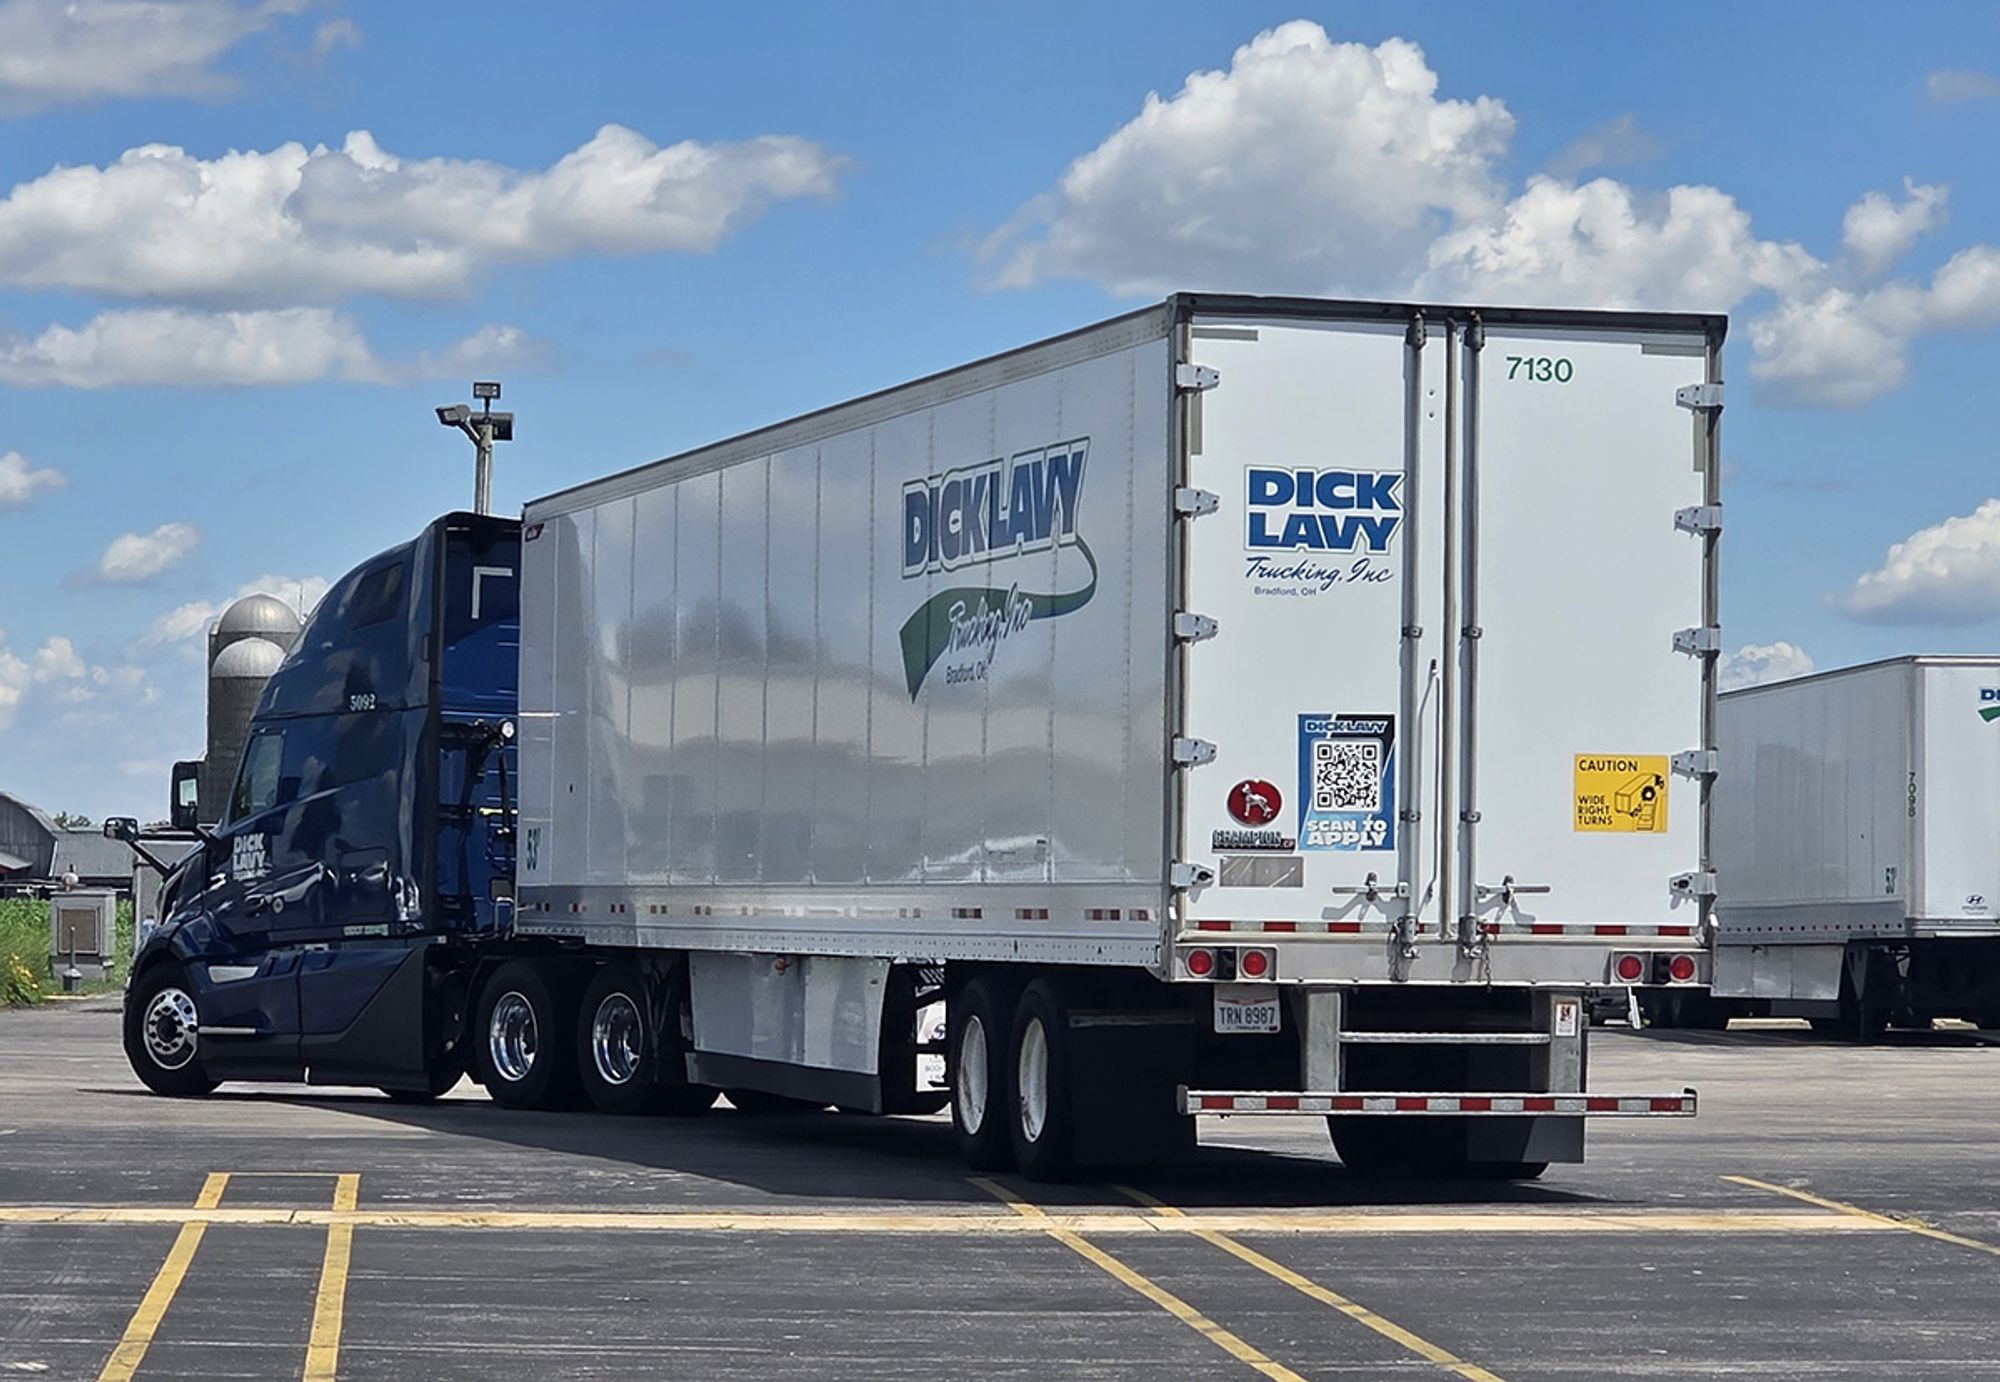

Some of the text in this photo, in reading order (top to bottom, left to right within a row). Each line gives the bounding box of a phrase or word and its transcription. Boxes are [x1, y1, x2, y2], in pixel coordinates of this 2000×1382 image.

[1506, 356, 1573, 383] 7130
[1249, 469, 1402, 510] DICK
[904, 449, 1085, 569] DICK LAVY
[1249, 511, 1401, 551] LAVY
[1346, 557, 1394, 583] Inc
[1301, 587, 1317, 597] OH
[1306, 720, 1388, 733] DICK LAVY
[1579, 759, 1638, 772] CAUTION
[1578, 795, 1606, 805] WIDE
[1578, 805, 1610, 815] RIGHT
[1307, 820, 1387, 832] SCAN TO
[1578, 815, 1613, 825] TURNS
[233, 833, 265, 853] DICK
[1212, 829, 1281, 846] CHAMPION
[1307, 831, 1387, 847] APPLY
[233, 850, 266, 871] LAVY
[1219, 1007, 1275, 1025] TRN 8987
